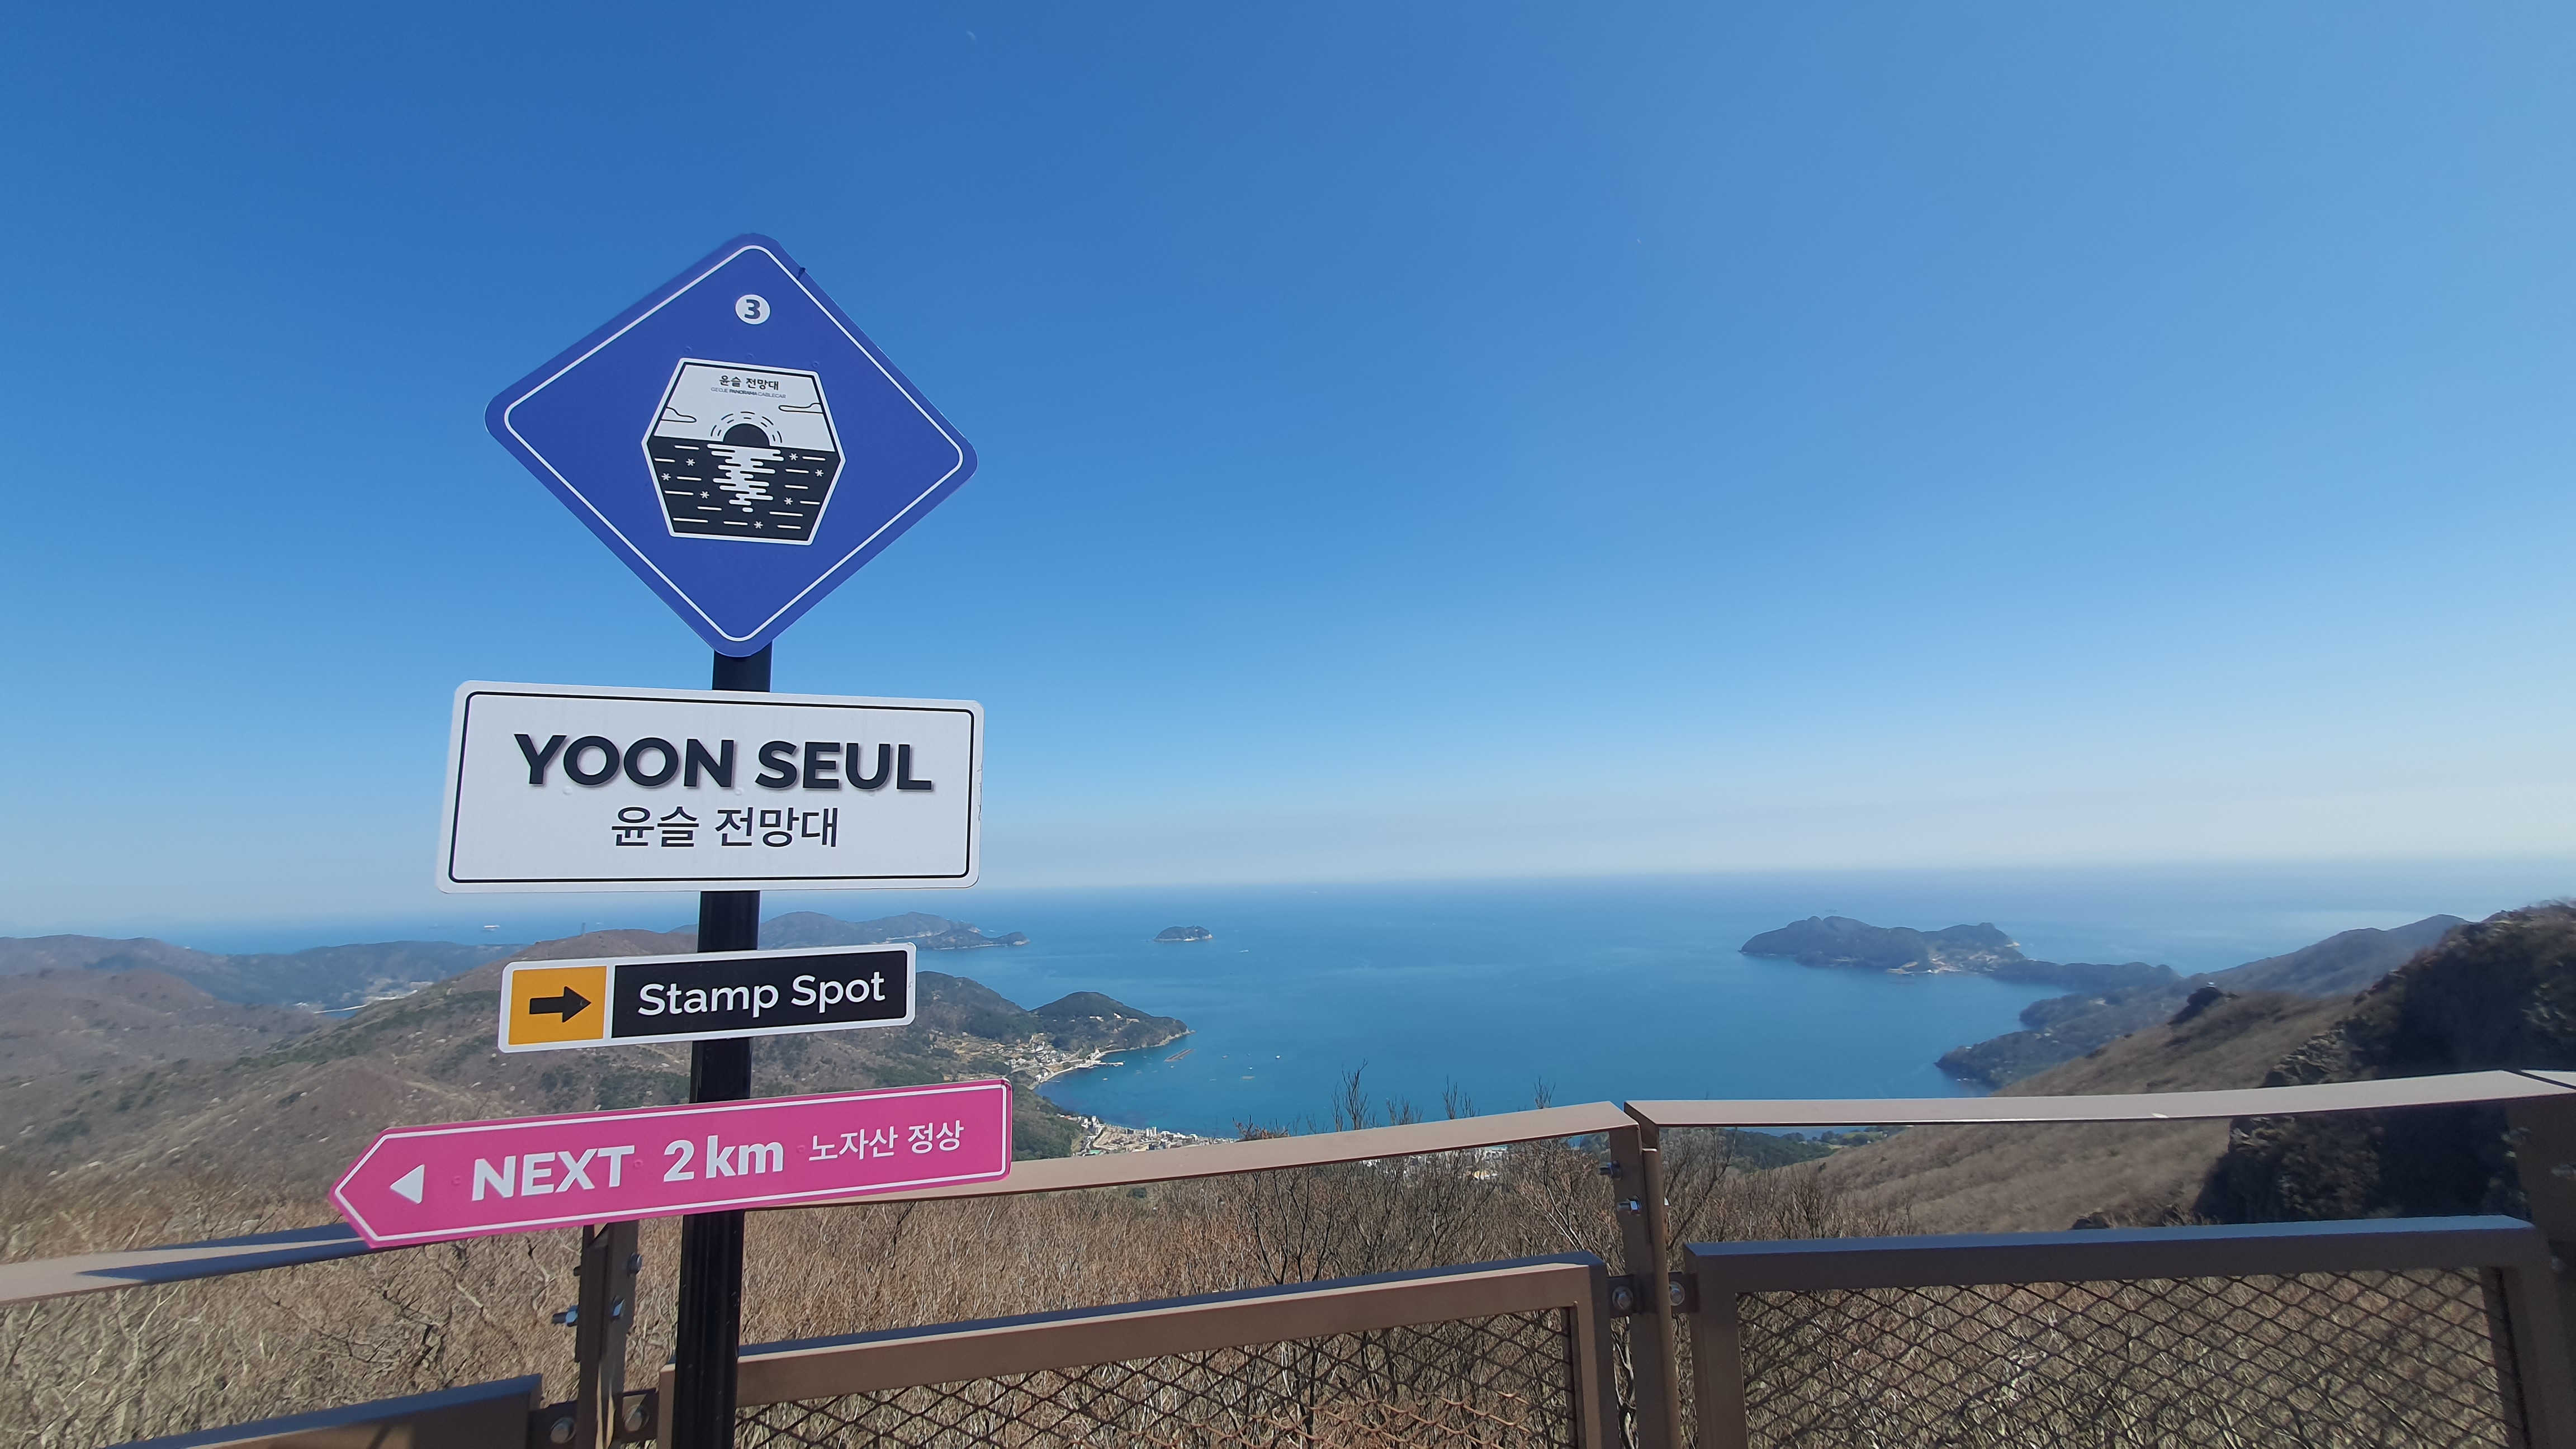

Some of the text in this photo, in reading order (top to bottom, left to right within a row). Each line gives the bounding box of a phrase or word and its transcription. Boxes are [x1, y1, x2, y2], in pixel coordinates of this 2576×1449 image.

[744, 299, 762, 319] 3
[719, 375, 779, 391] 윤슬 전망대
[514, 734, 934, 792] YOON SEUL
[612, 807, 837, 847] 윤슬 전망대
[638, 972, 886, 1018] Stamp Spot
[472, 1145, 634, 1201] NEXT
[809, 1126, 898, 1161] 노자산
[908, 1120, 964, 1153] 정상
